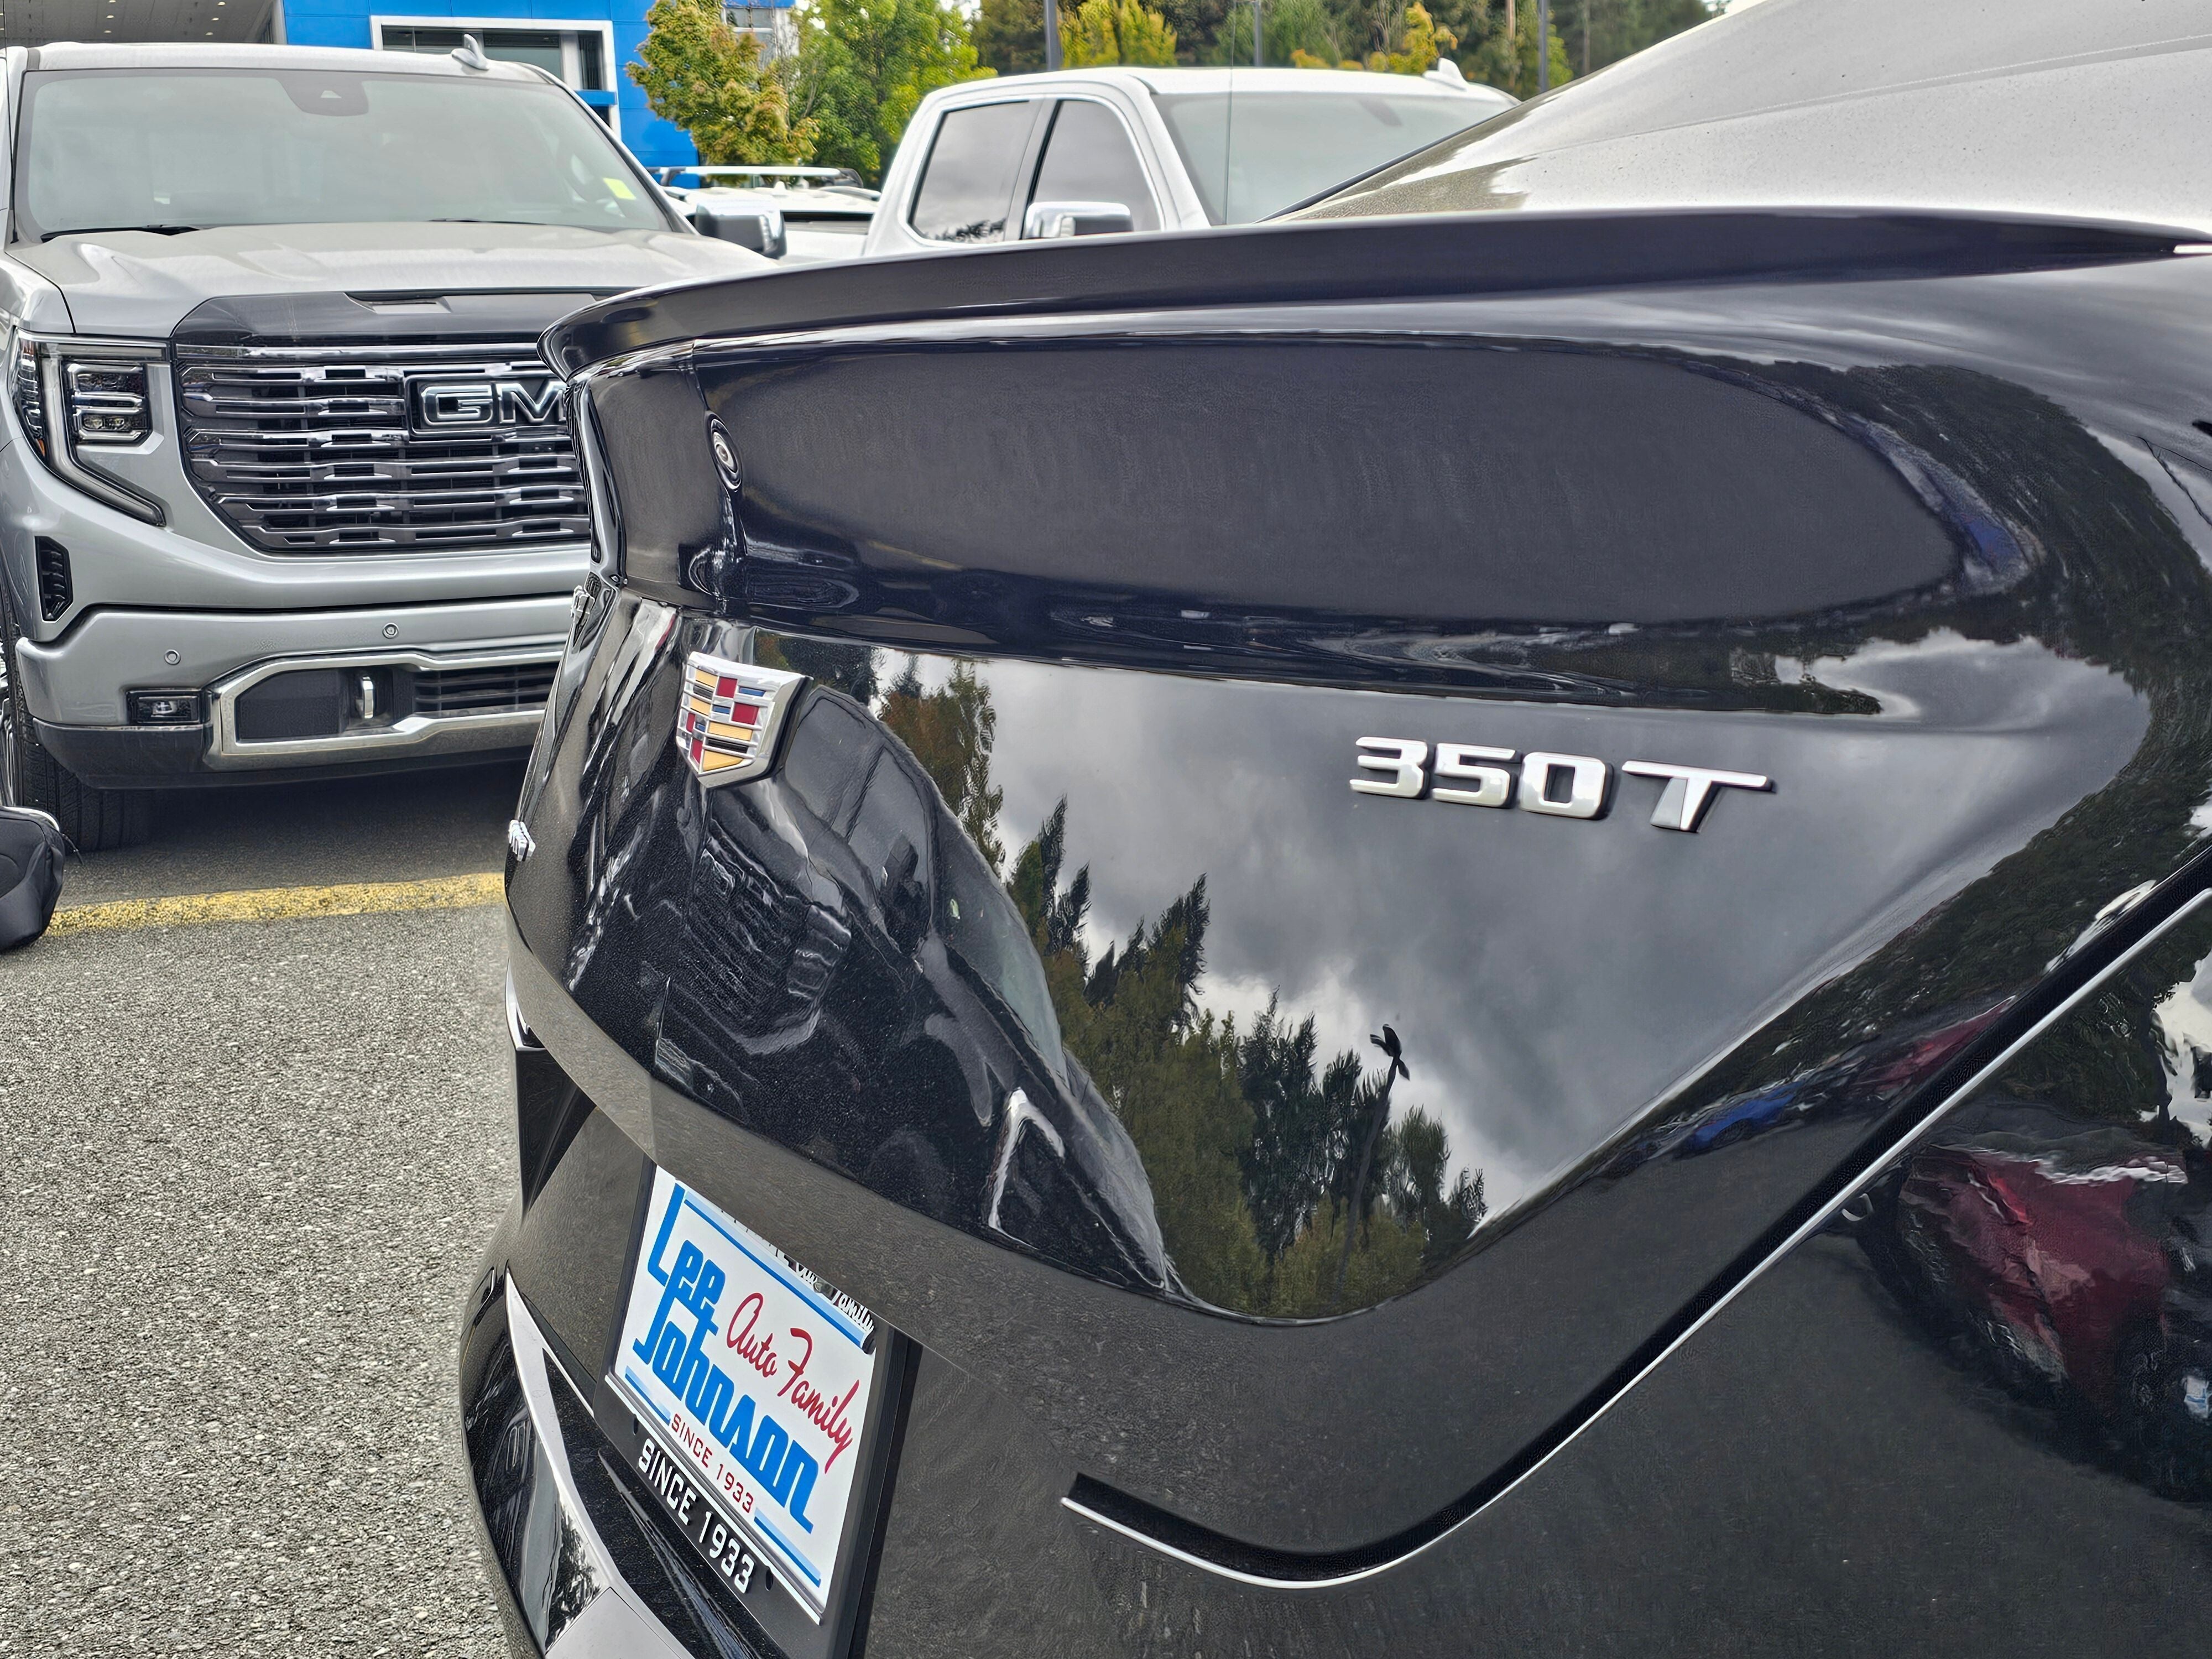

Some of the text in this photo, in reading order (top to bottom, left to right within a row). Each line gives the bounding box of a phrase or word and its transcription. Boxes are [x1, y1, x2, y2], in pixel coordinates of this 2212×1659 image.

[647, 1182, 726, 1311] Lee
[633, 1284, 818, 1534] Johnson
[726, 1292, 859, 1474] Auto Family
[638, 1438, 757, 1594] SINCE 1933
[671, 1413, 754, 1514] SINCE 1933
